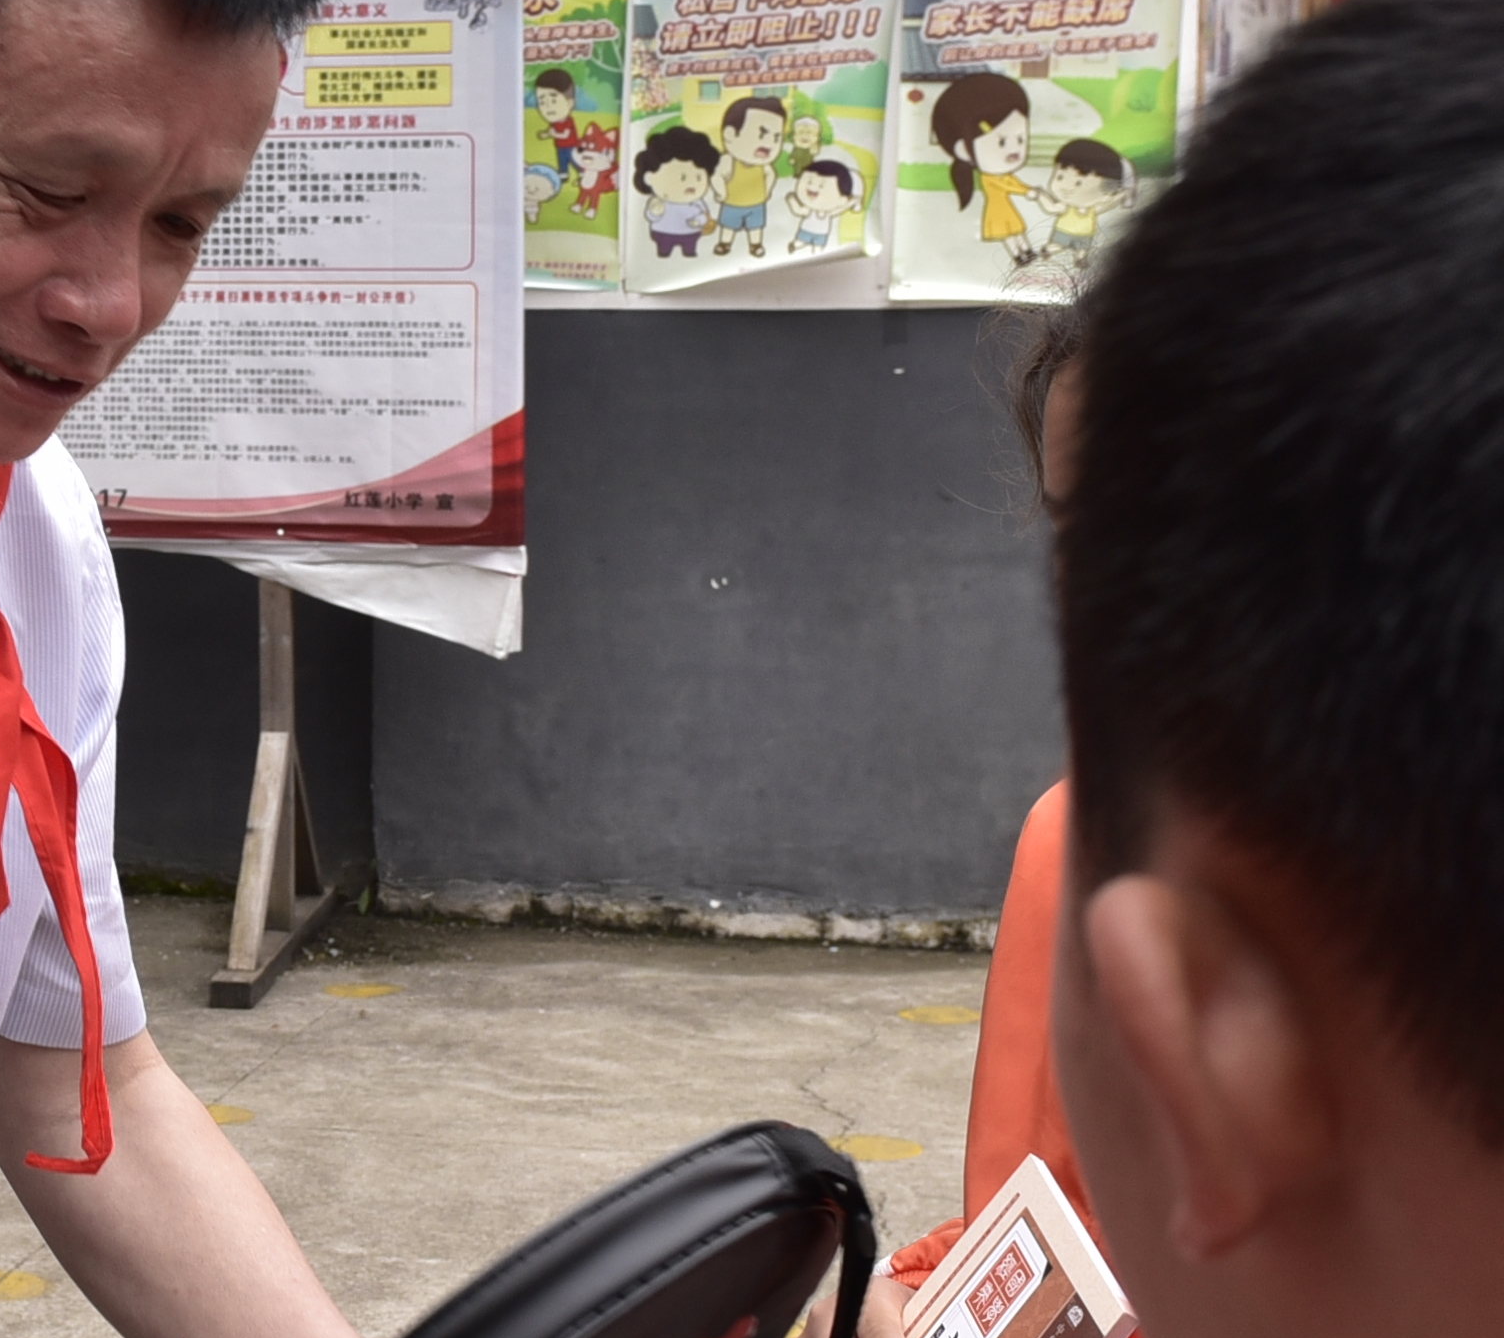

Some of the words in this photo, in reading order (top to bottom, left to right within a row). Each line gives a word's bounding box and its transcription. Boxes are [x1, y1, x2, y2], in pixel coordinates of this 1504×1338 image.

[307, 2, 388, 19] 重大意义
[344, 491, 423, 511] 红莲小学
[436, 492, 455, 511] 宣
